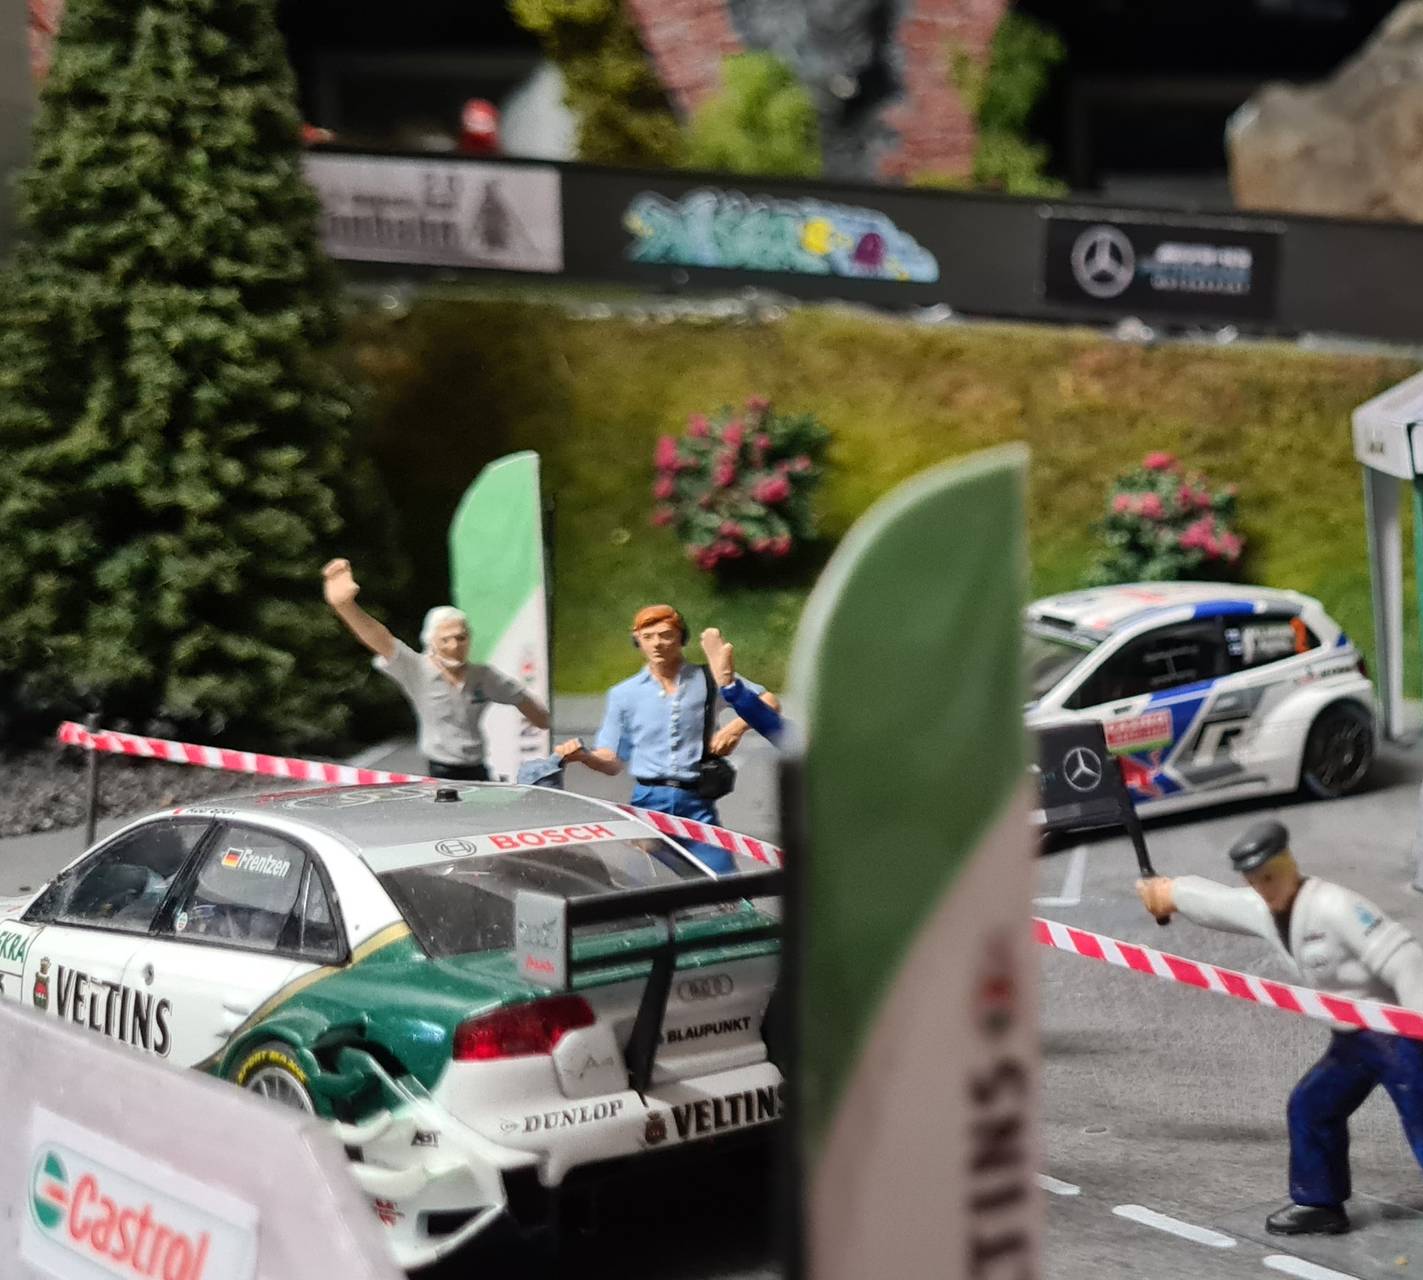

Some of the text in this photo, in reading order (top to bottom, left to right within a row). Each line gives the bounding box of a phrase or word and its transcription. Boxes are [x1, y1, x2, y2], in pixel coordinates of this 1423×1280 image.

[488, 824, 616, 850] BOSCH
[239, 850, 291, 878] Frentzen
[57, 964, 173, 1058] VELTINS
[667, 1016, 751, 1044] BLAUPUNKT
[523, 1099, 624, 1133] DUNLOP
[968, 1057, 1030, 1280] TINS
[69, 1173, 213, 1280] Castrol
